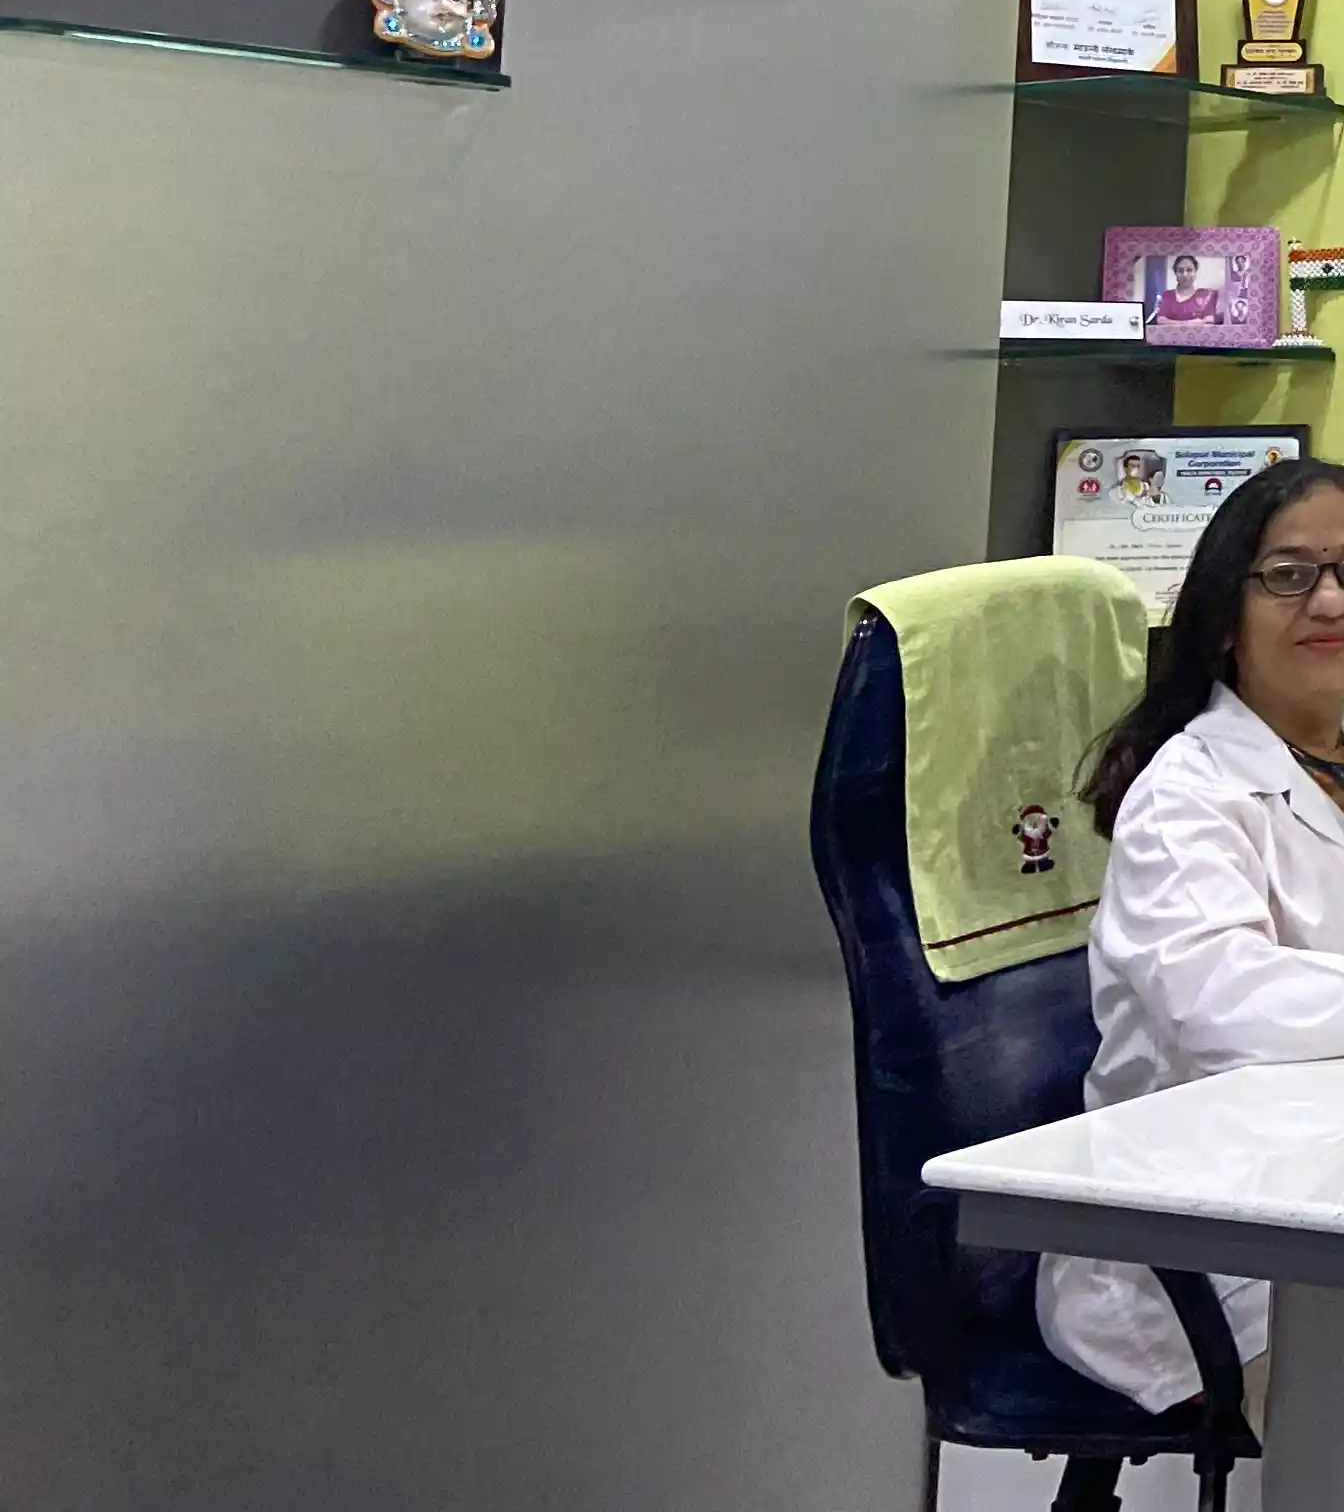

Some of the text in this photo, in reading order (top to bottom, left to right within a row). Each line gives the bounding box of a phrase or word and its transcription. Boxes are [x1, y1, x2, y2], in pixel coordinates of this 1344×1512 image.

[1019, 313, 1113, 328] Dr. Kiran Sarda
